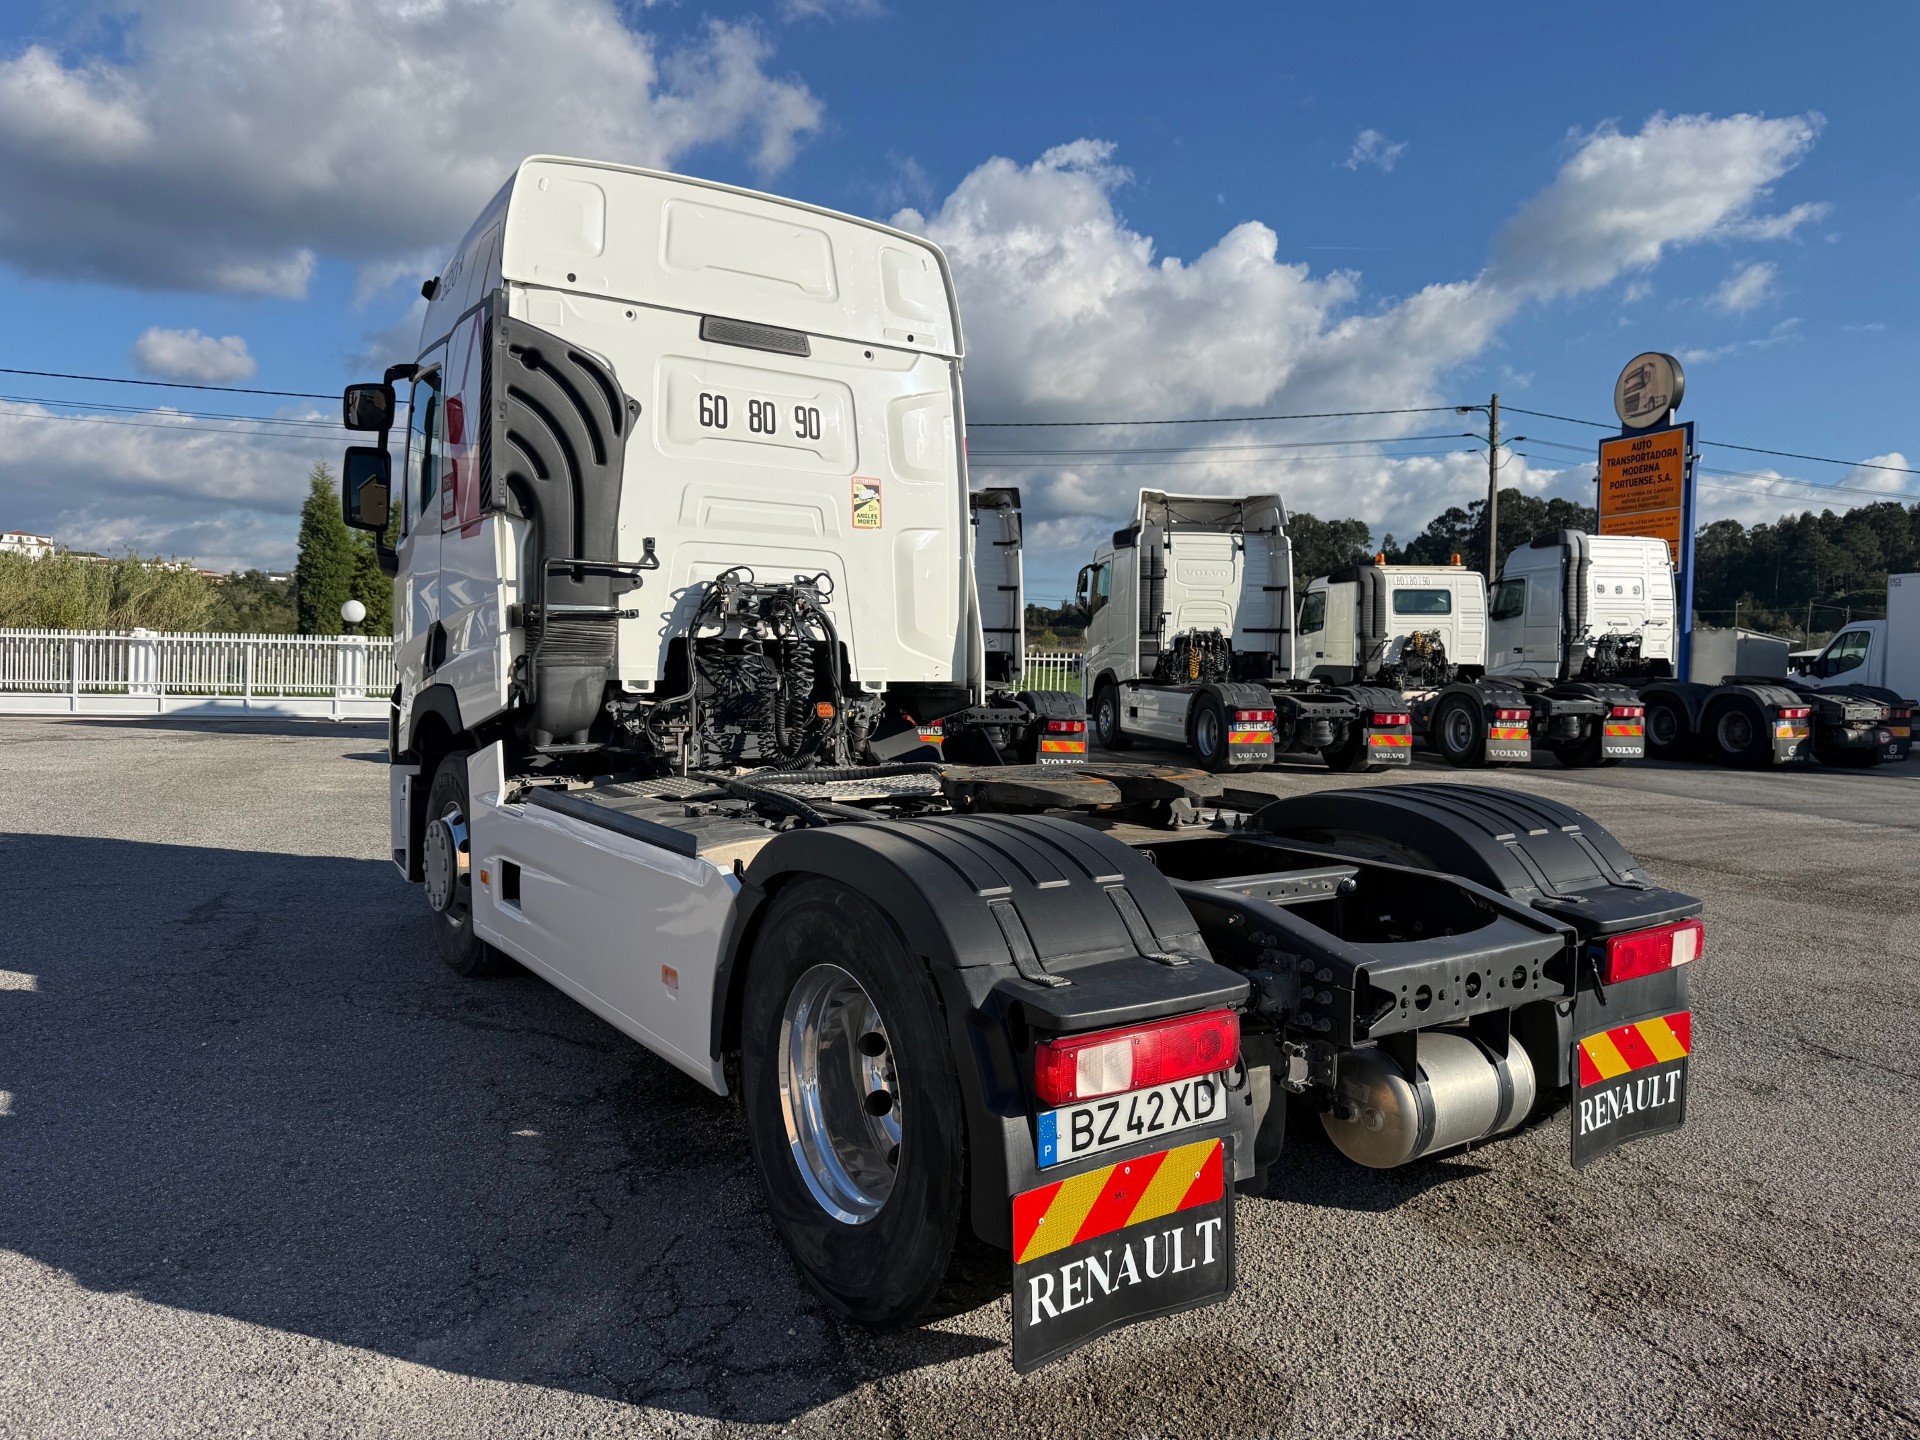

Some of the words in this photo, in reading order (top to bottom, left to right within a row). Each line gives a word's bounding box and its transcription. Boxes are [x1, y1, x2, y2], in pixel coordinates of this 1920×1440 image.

[699, 392, 728, 430] 60
[748, 399, 776, 435] 80
[794, 405, 821, 440] 90
[1631, 440, 1652, 452] AUTO
[1607, 447, 1678, 467] TRANSPORTADORA
[1622, 463, 1660, 477] MODERNA
[1610, 476, 1656, 490] PORTUENSE,
[1657, 473, 1673, 483] S.A.
[1184, 568, 1228, 577] VOLVO
[1596, 584, 1605, 594] 60
[1632, 585, 1641, 595] 90
[1489, 749, 1528, 757] VOLVO
[1605, 746, 1642, 754] VOLVO
[1579, 1069, 1681, 1136] RENAULT
[1044, 1144, 1053, 1158] P
[1028, 1217, 1222, 1327] RENAULT
